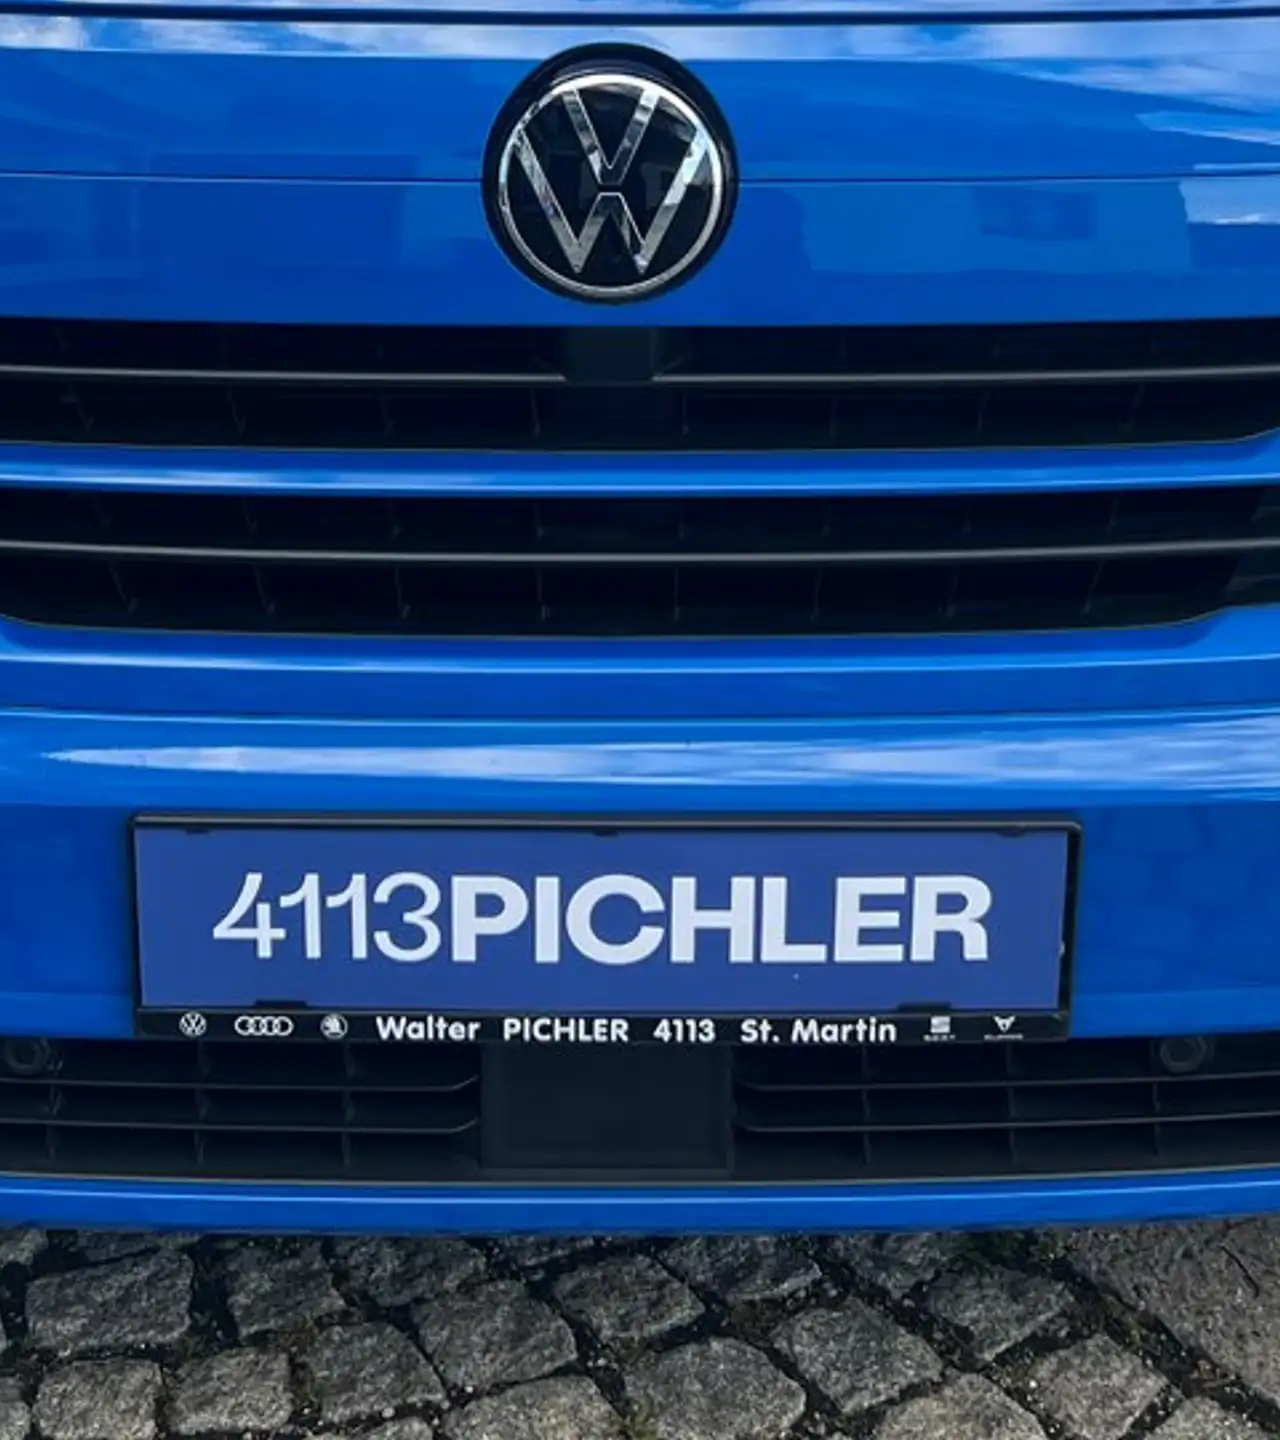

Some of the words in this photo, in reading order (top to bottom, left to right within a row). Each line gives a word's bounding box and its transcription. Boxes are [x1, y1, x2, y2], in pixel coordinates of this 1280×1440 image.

[510, 86, 711, 277] VW
[376, 1013, 481, 1041] Walter
[503, 1017, 629, 1043] PICHLER
[653, 1018, 716, 1043] 4113
[741, 1018, 780, 1044] St.
[792, 1016, 897, 1044] Martin
